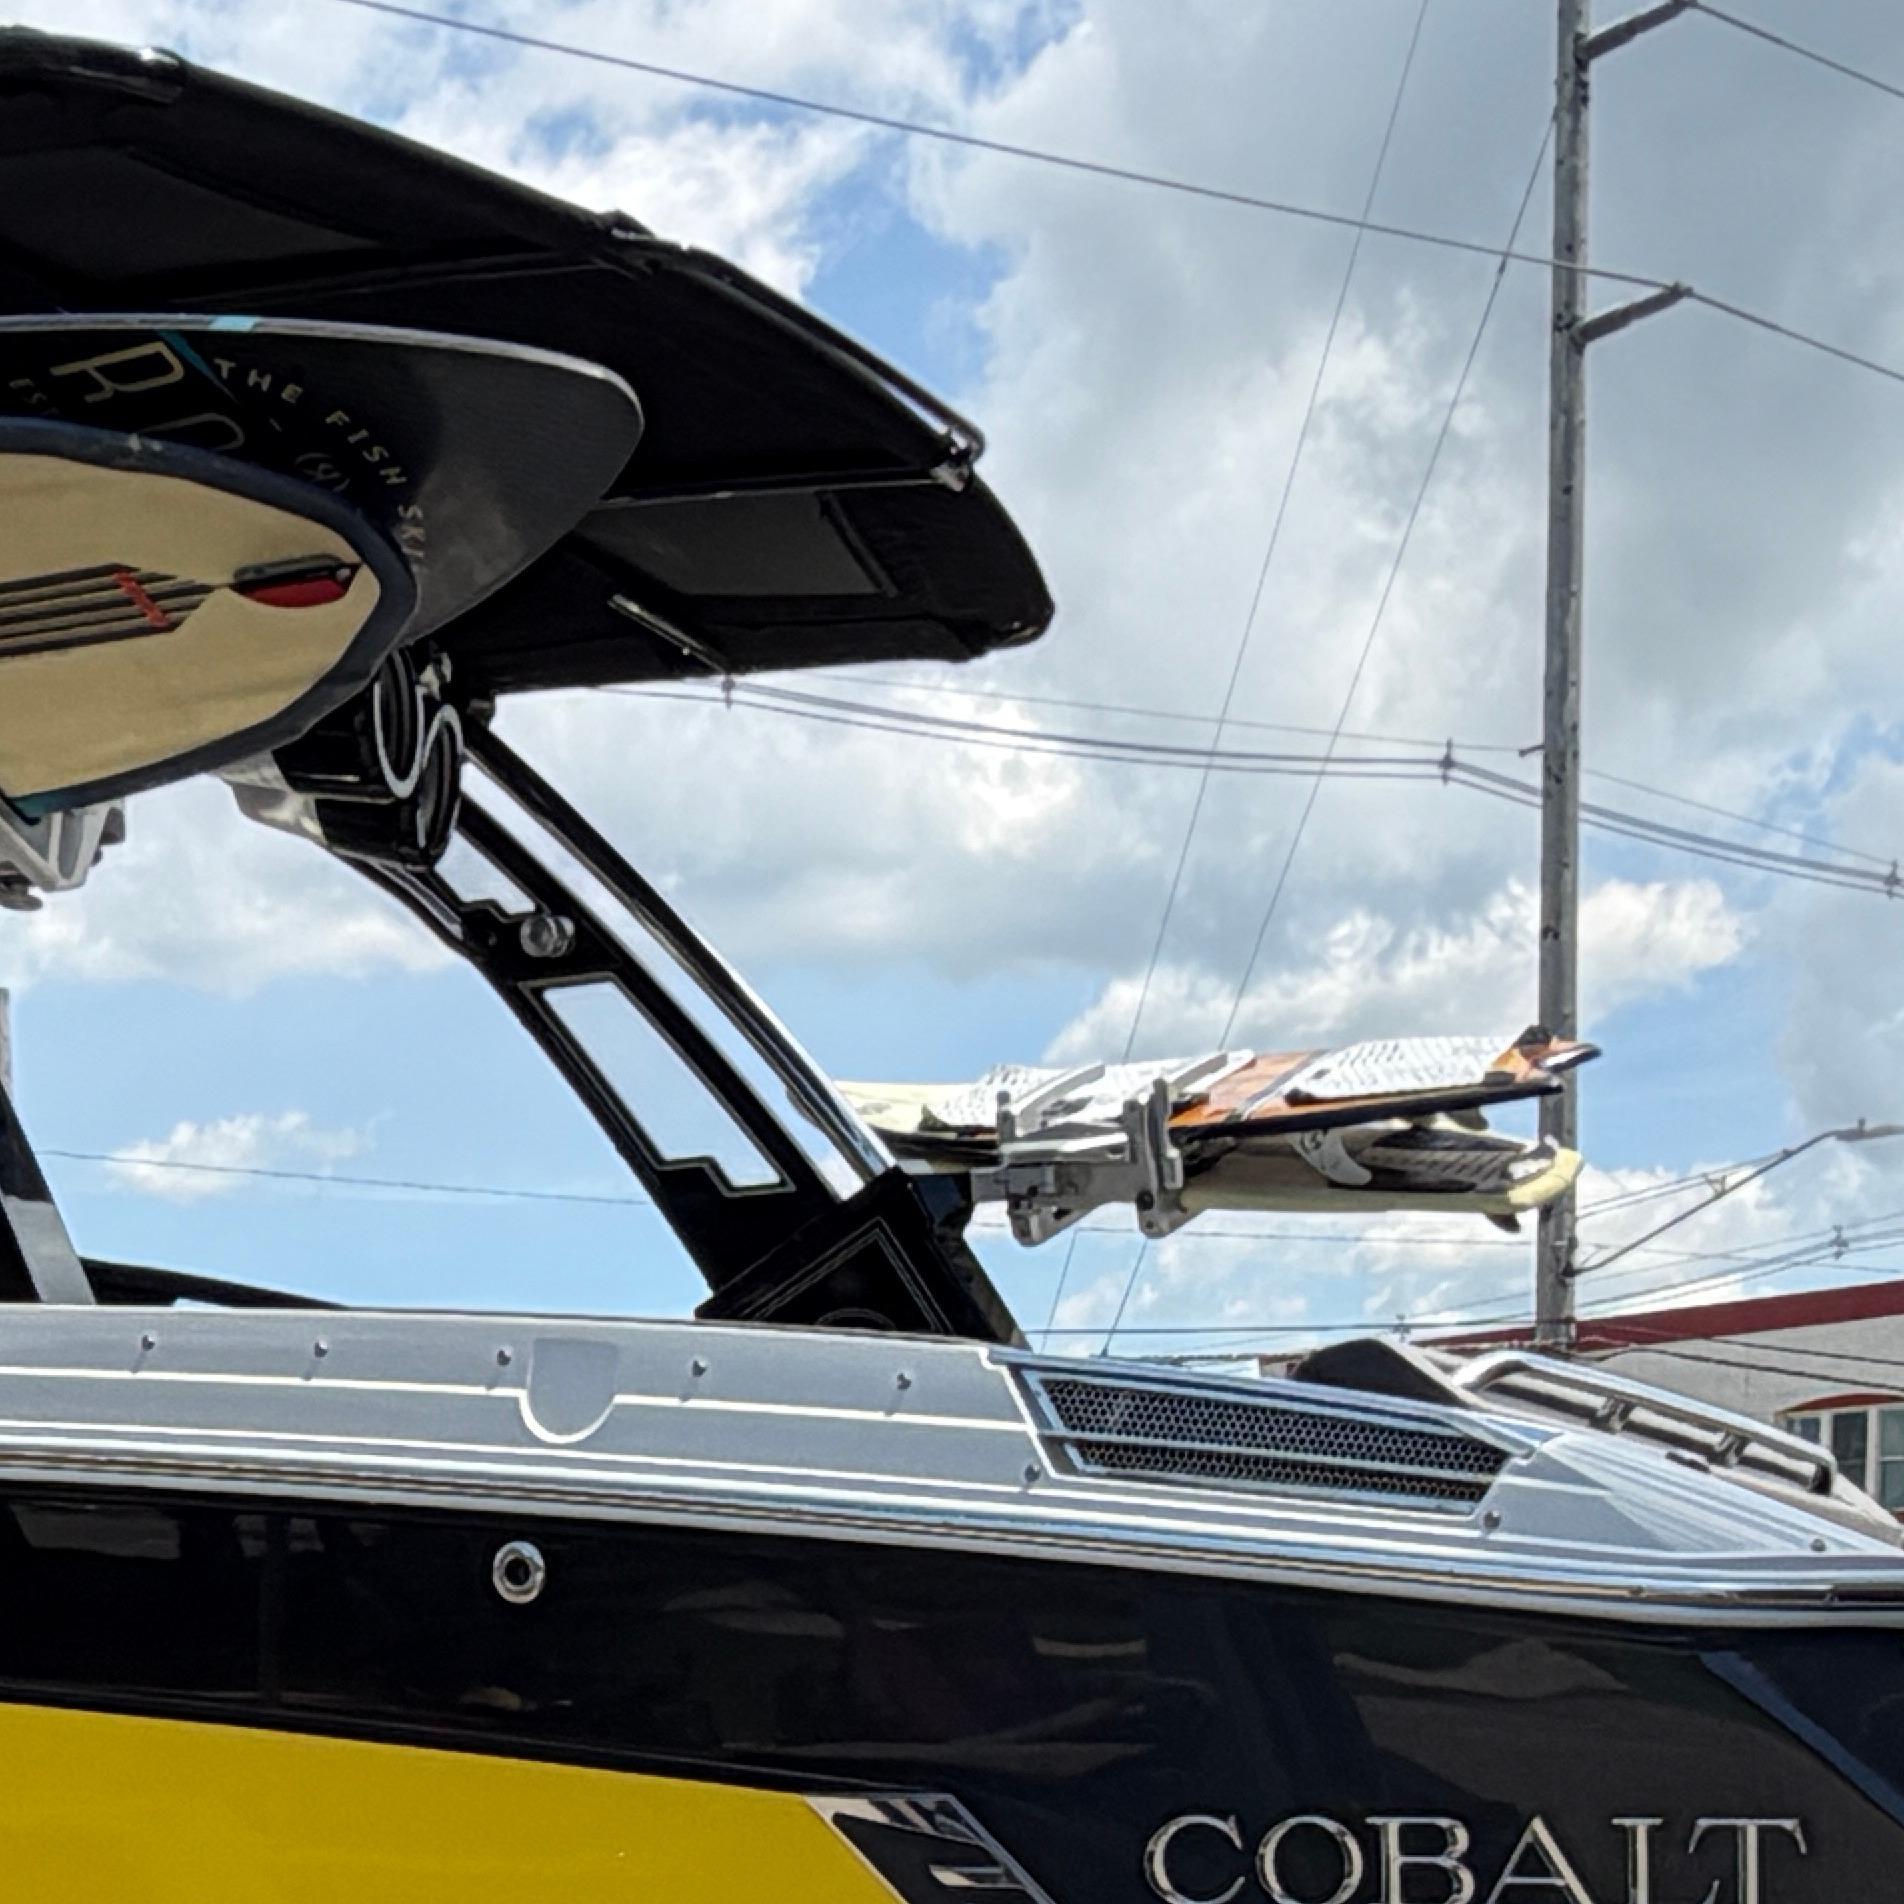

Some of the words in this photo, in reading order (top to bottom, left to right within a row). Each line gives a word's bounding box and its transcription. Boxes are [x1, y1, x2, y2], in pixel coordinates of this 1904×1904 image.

[213, 357, 304, 403] THE
[324, 410, 409, 486] FISH
[397, 503, 427, 574] SKI
